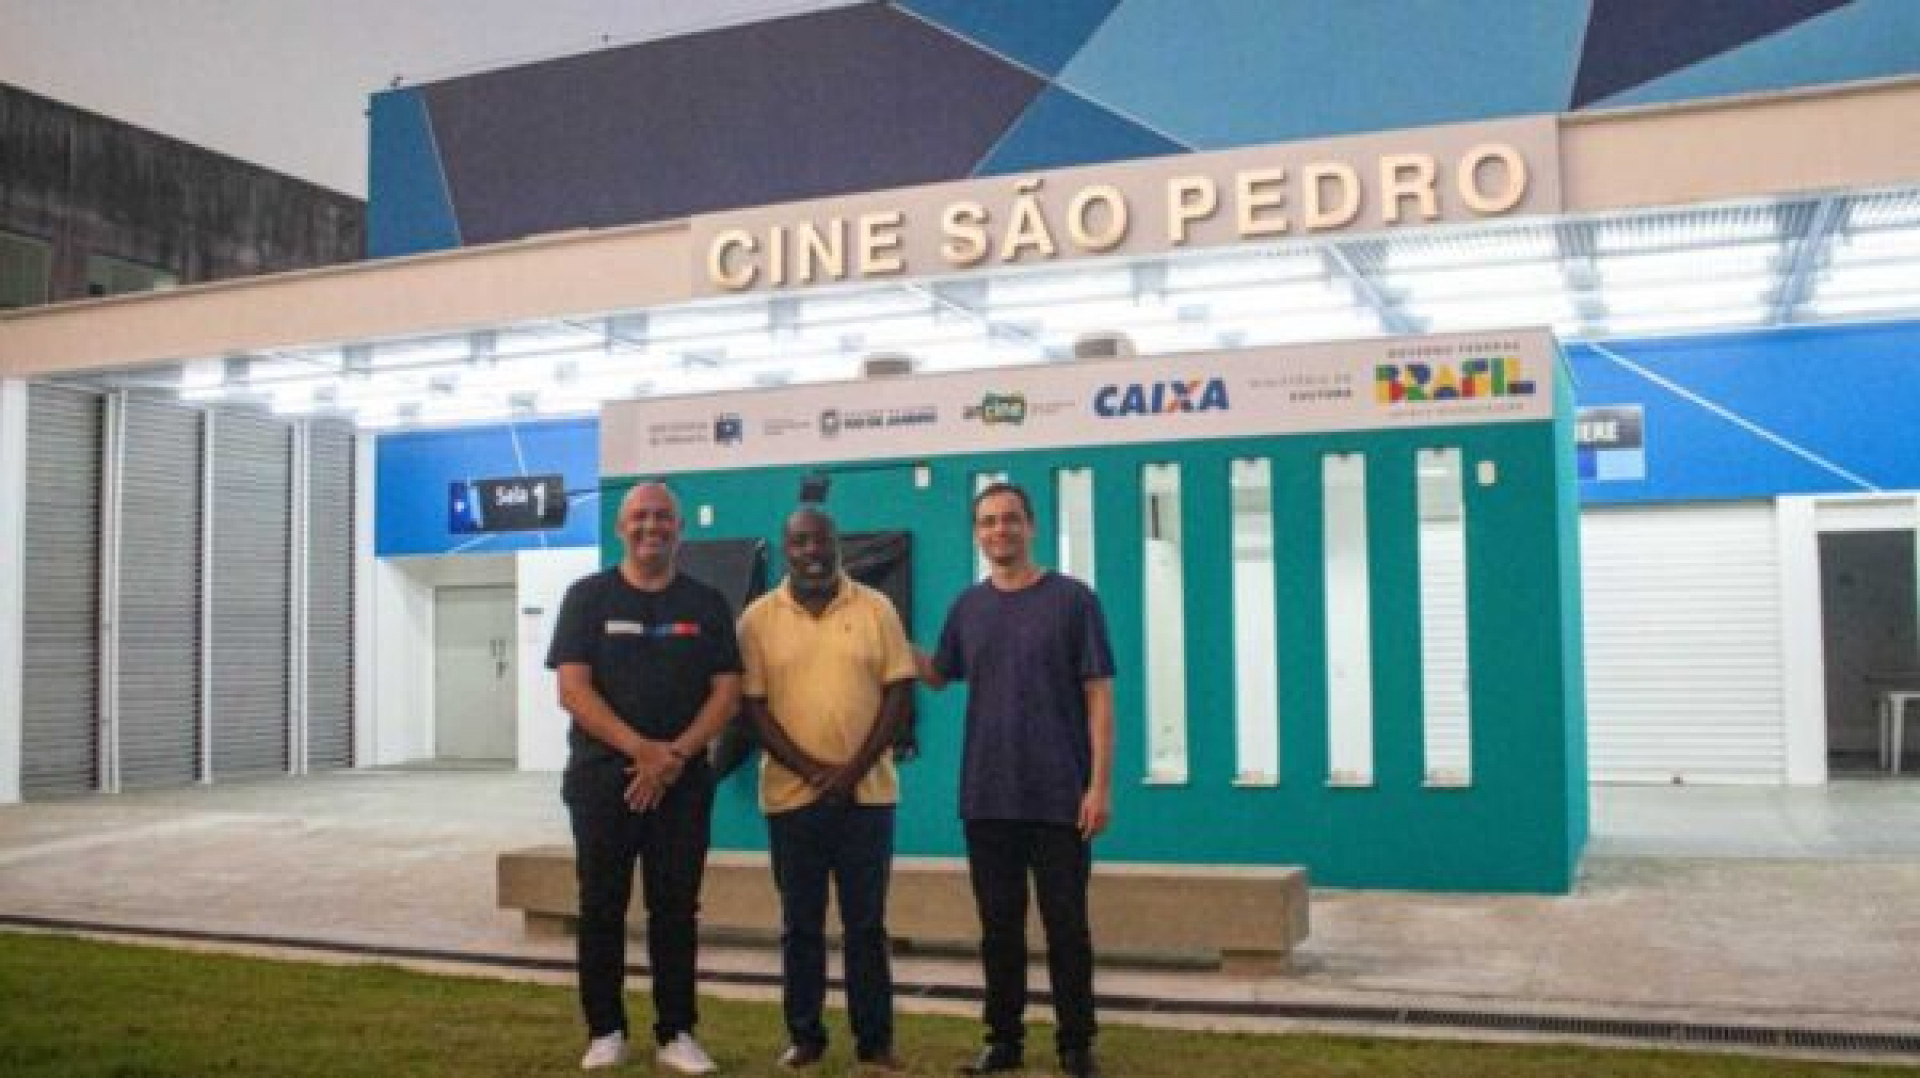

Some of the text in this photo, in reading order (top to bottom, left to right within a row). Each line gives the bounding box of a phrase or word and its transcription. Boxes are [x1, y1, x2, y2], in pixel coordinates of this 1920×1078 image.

[707, 142, 1530, 291] CINE SÃO PEDRO
[1093, 377, 1230, 417] CAIXA
[1376, 357, 1536, 404] BRASIL
[495, 482, 546, 518] Sala 1
